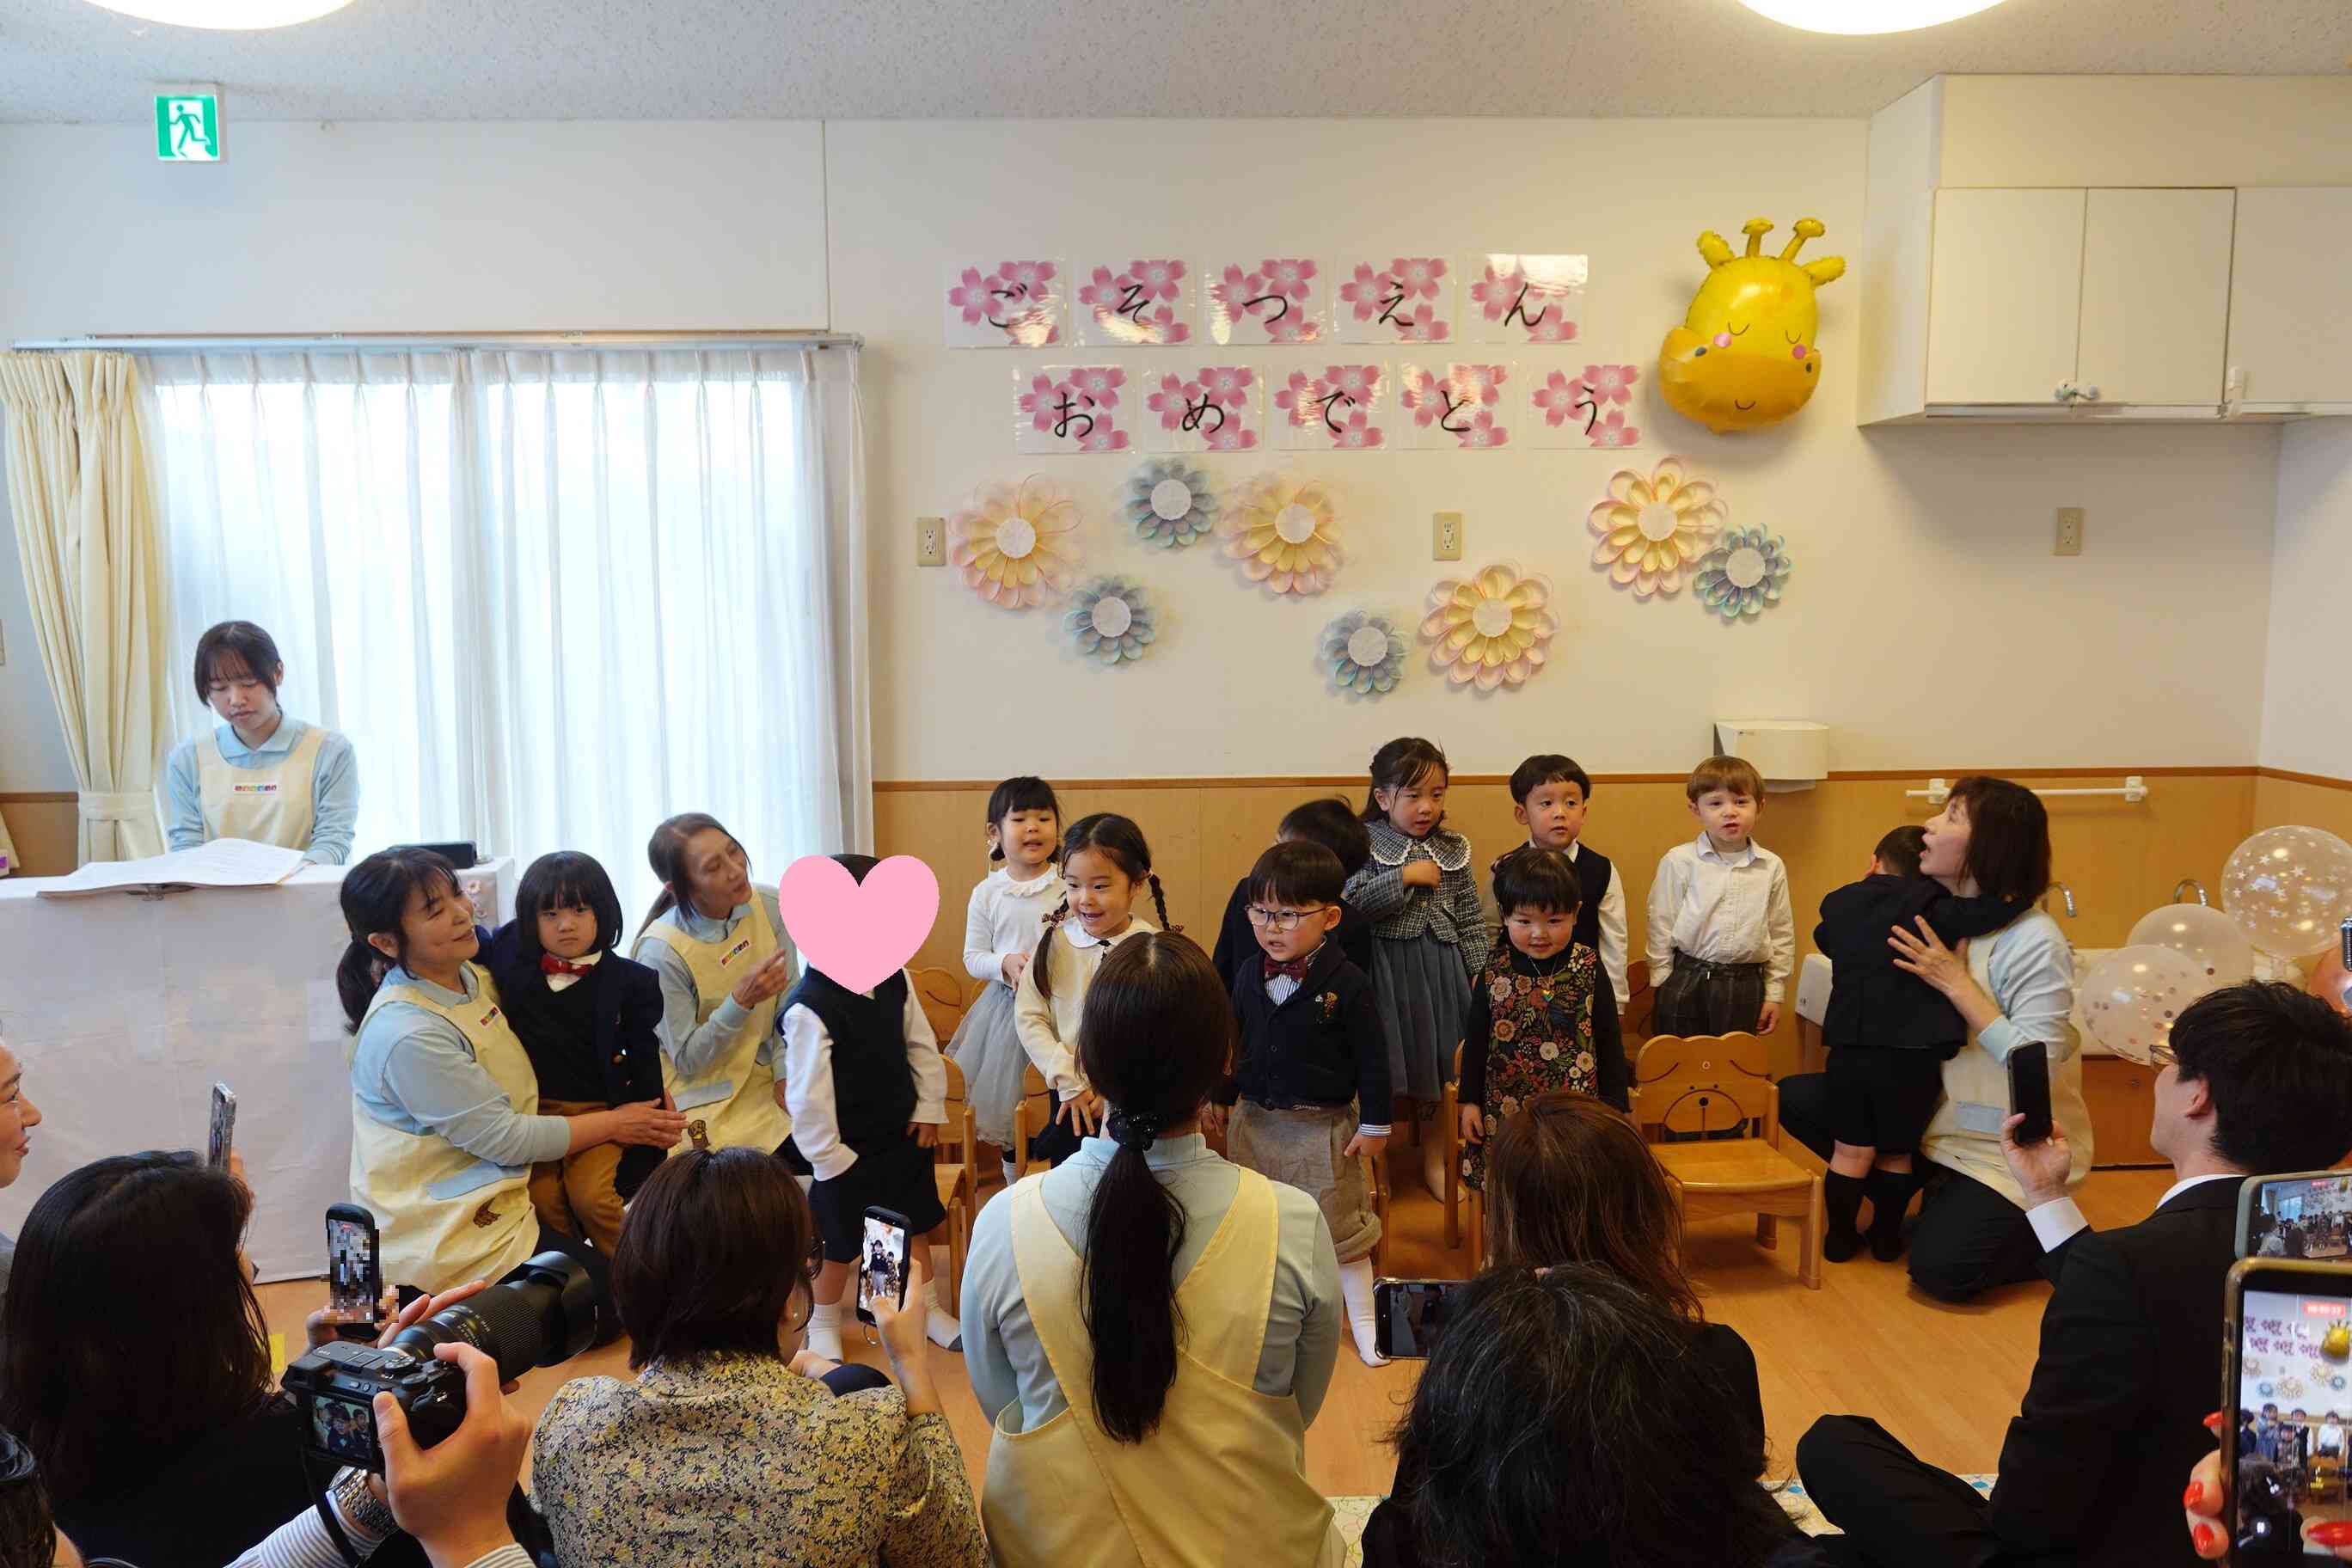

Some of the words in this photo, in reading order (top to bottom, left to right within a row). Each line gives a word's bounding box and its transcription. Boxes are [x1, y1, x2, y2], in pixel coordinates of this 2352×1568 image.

[989, 281, 1545, 328] ごそつえん
[1053, 386, 1597, 438] おめでとう
